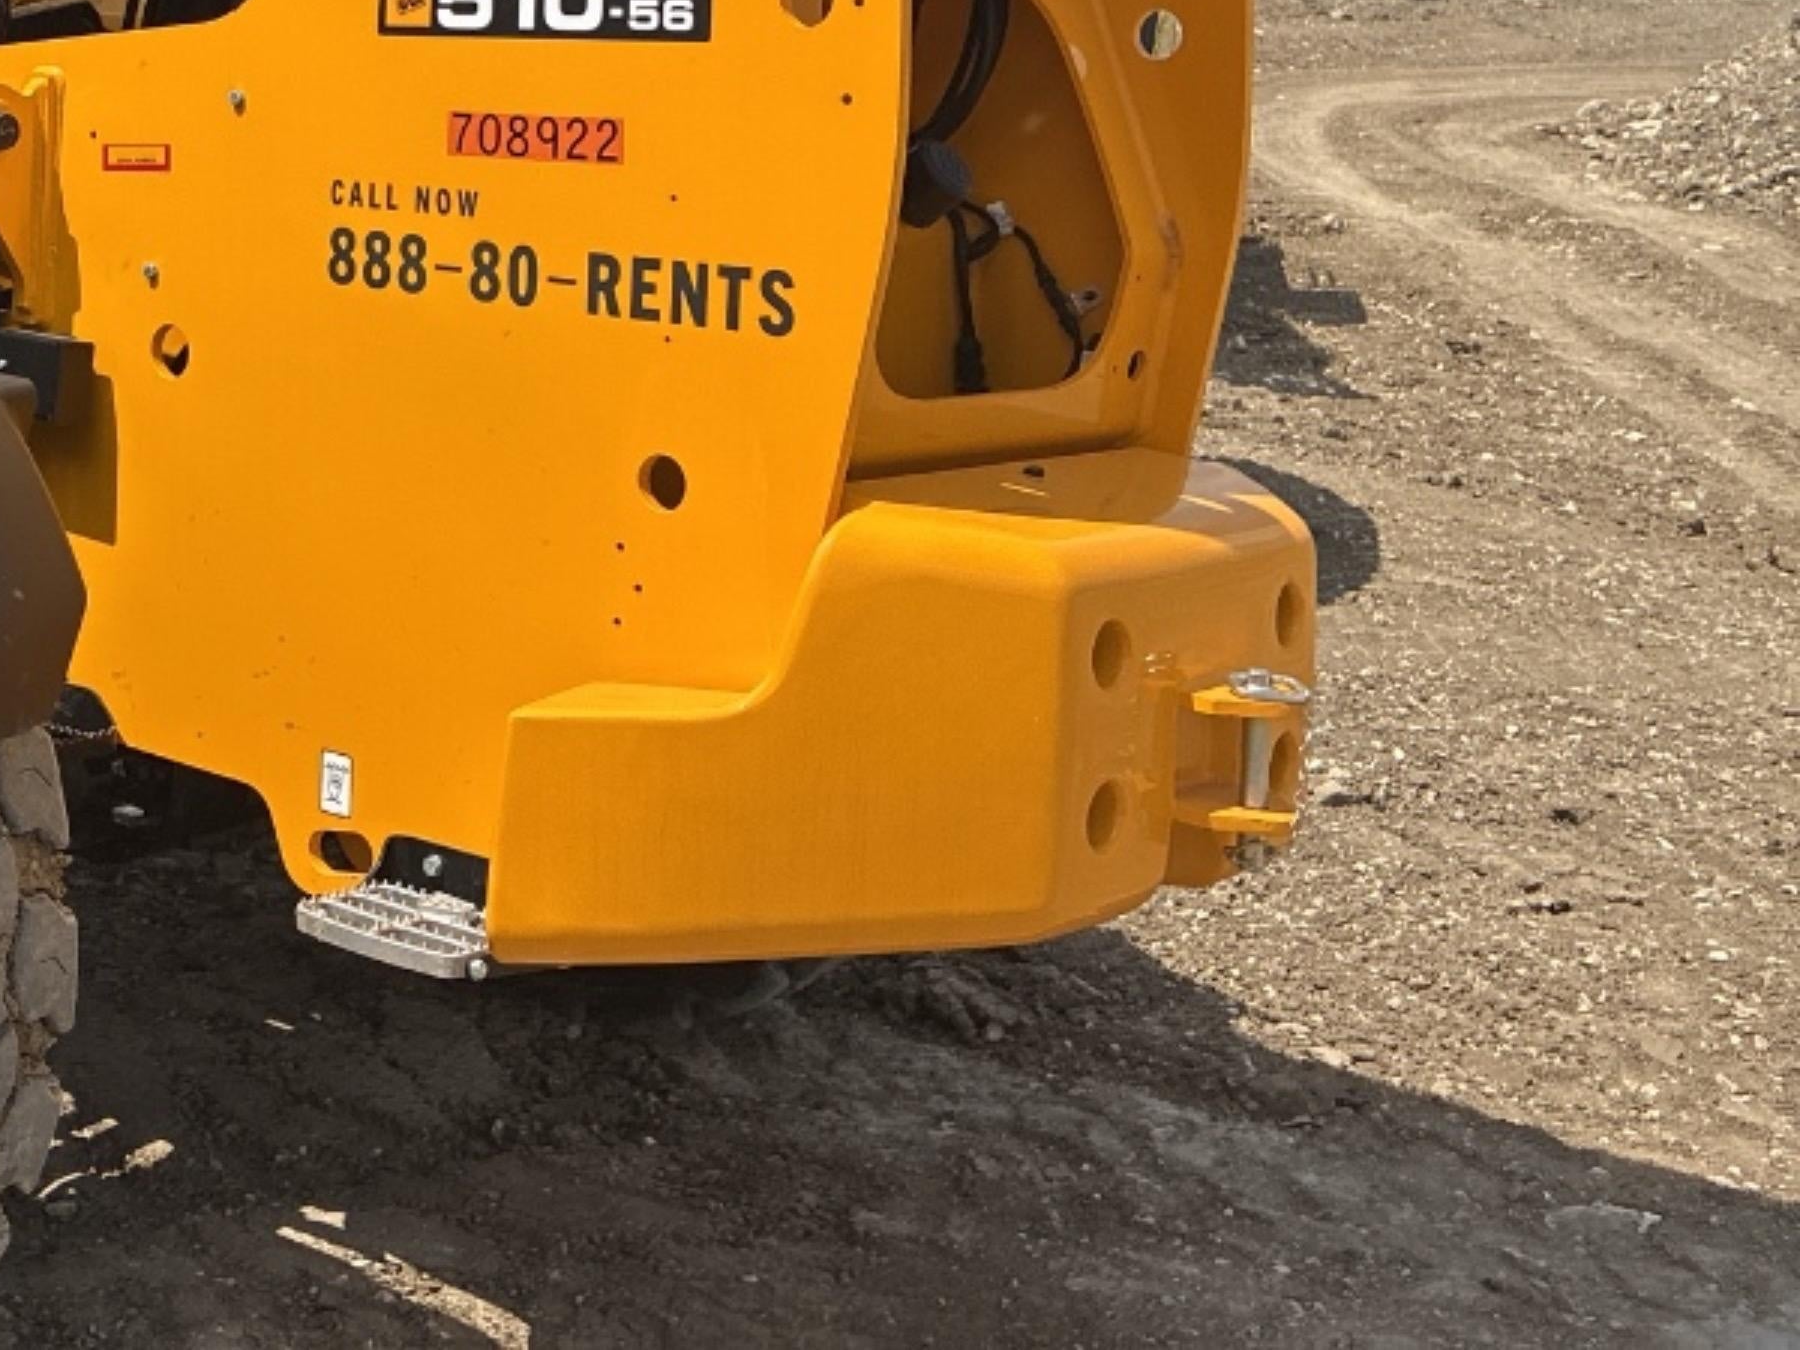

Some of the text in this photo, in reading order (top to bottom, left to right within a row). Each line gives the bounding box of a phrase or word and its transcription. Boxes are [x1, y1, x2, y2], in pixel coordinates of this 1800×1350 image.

[451, 112, 620, 163] 708922
[330, 180, 479, 219] CALL NOW
[328, 226, 796, 338] 888-80-RENTS
